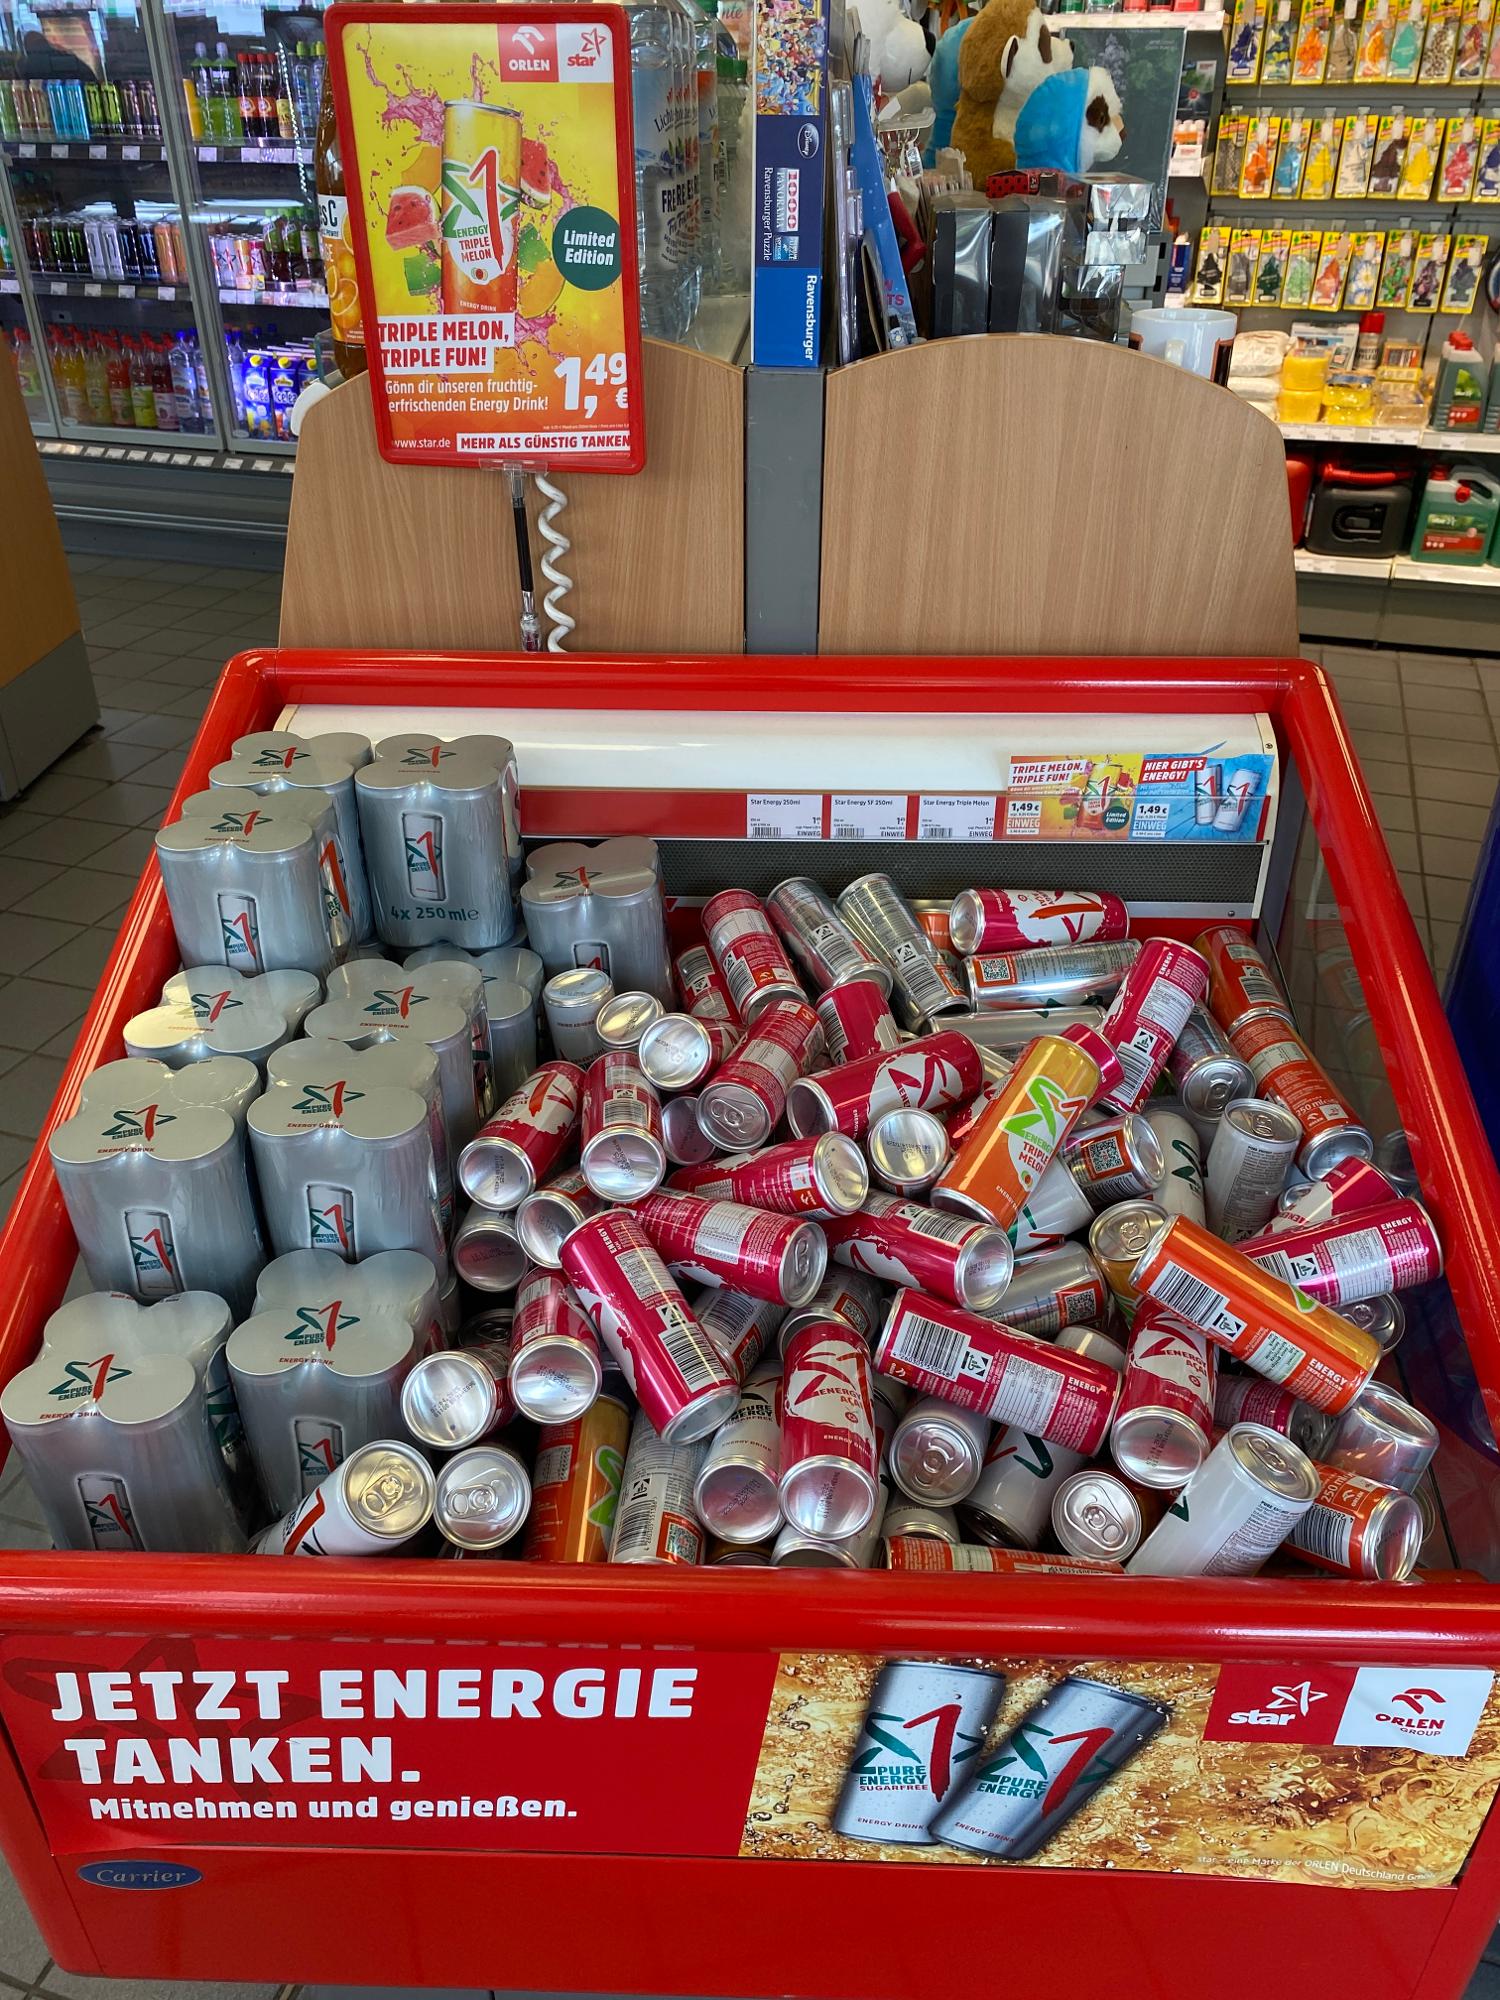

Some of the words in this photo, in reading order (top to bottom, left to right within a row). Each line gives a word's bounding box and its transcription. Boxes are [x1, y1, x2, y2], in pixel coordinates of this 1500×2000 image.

[508, 59, 550, 72] ORLEN
[567, 54, 597, 67] star
[802, 129, 814, 156] Disney
[763, 168, 774, 230] Ravensburger
[776, 171, 786, 228] PANORAMA
[787, 171, 798, 229] 1000
[457, 224, 489, 238] ENERGY
[459, 236, 490, 251] TRIPLE
[563, 229, 616, 248] Limited
[763, 232, 773, 261] Puzzle
[461, 249, 492, 263] MELON
[565, 247, 614, 266] Edition
[459, 300, 480, 310] ENERGY
[480, 304, 497, 313] DRINK
[803, 275, 818, 361] Ravensburger
[378, 321, 438, 342] TRIPLE
[442, 320, 509, 343] MELON,
[382, 348, 441, 368] TRIPLE
[445, 347, 487, 366] FUN!
[386, 380, 415, 394] Gönn
[418, 380, 434, 394] dir
[437, 381, 484, 393] unseren
[487, 379, 538, 396] fruchtig-
[388, 398, 467, 412] erfrischenden
[470, 398, 510, 414] Energy
[513, 396, 549, 411] Drink!
[393, 438, 451, 449] www.star.de
[461, 437, 495, 449] MEHR
[498, 436, 521, 448] ALS
[524, 434, 578, 448] GÜNSTIG
[581, 435, 630, 447] TANKEN
[1013, 764, 1046, 774] TRIPLE
[1047, 762, 1083, 773] MELON,
[1144, 761, 1169, 771] HIER
[1170, 759, 1203, 769] GIBT'S
[1012, 774, 1045, 784] TRIPLE
[1046, 773, 1070, 783] FUN!
[1142, 770, 1187, 781] ENERGY!
[763, 799, 783, 807] Energy
[847, 799, 866, 807] Energy
[956, 799, 972, 807] Triple
[1011, 803, 1033, 812] 1,49
[1139, 805, 1161, 814] 1,49
[1007, 818, 1040, 828] EINWEG
[1133, 820, 1167, 830] EINWEG
[797, 830, 821, 838] EINWEG
[391, 906, 412, 921] 4x
[416, 907, 446, 920] 250
[1159, 952, 1174, 976] ENERGY
[112, 1131, 143, 1140] ENERGY
[1381, 1216, 1413, 1231] ENERGY
[597, 1227, 618, 1255] ENERGY
[293, 1338, 325, 1346] ENERGY
[304, 1333, 325, 1341] PURE
[1165, 1349, 1206, 1367] ENERGY
[1310, 1358, 1348, 1386] ENERGY
[70, 1386, 93, 1394] PURE
[1068, 1376, 1102, 1394] ENERGY
[58, 1390, 92, 1400] ENERGY
[822, 1388, 861, 1400] ENERGY
[740, 1404, 773, 1412] PURE
[40, 1412, 75, 1420] ENERGY
[824, 1434, 852, 1445] ENERGY
[51, 1670, 290, 1722] JETZT
[320, 1667, 699, 1719] ENERGIE
[1228, 1708, 1296, 1726] star
[1375, 1713, 1445, 1730] ORLEN
[1400, 1727, 1441, 1737] GROUP
[64, 1736, 421, 1785] TANKEN.
[877, 1765, 927, 1777] PURE
[859, 1775, 927, 1786] ENERGY
[1001, 1776, 1048, 1790] PURE
[859, 1784, 928, 1792] SUGARFREE
[976, 1782, 1046, 1800] ENERGY
[91, 1796, 298, 1820] Mitnehmen
[309, 1796, 377, 1819] und
[390, 1795, 579, 1822] genießen.
[857, 1817, 893, 1828] ENERGY
[894, 1821, 925, 1831] DRINK
[955, 1821, 987, 1836] ENERGY
[987, 1831, 1017, 1844] DRINK
[95, 1866, 187, 1886] Carrier
[1198, 1856, 1217, 1864] star
[1252, 1857, 1283, 1867] Marke
[1285, 1858, 1302, 1868] der
[1304, 1859, 1340, 1873] ORLEN
[1341, 1862, 1405, 1882] Deutschland
